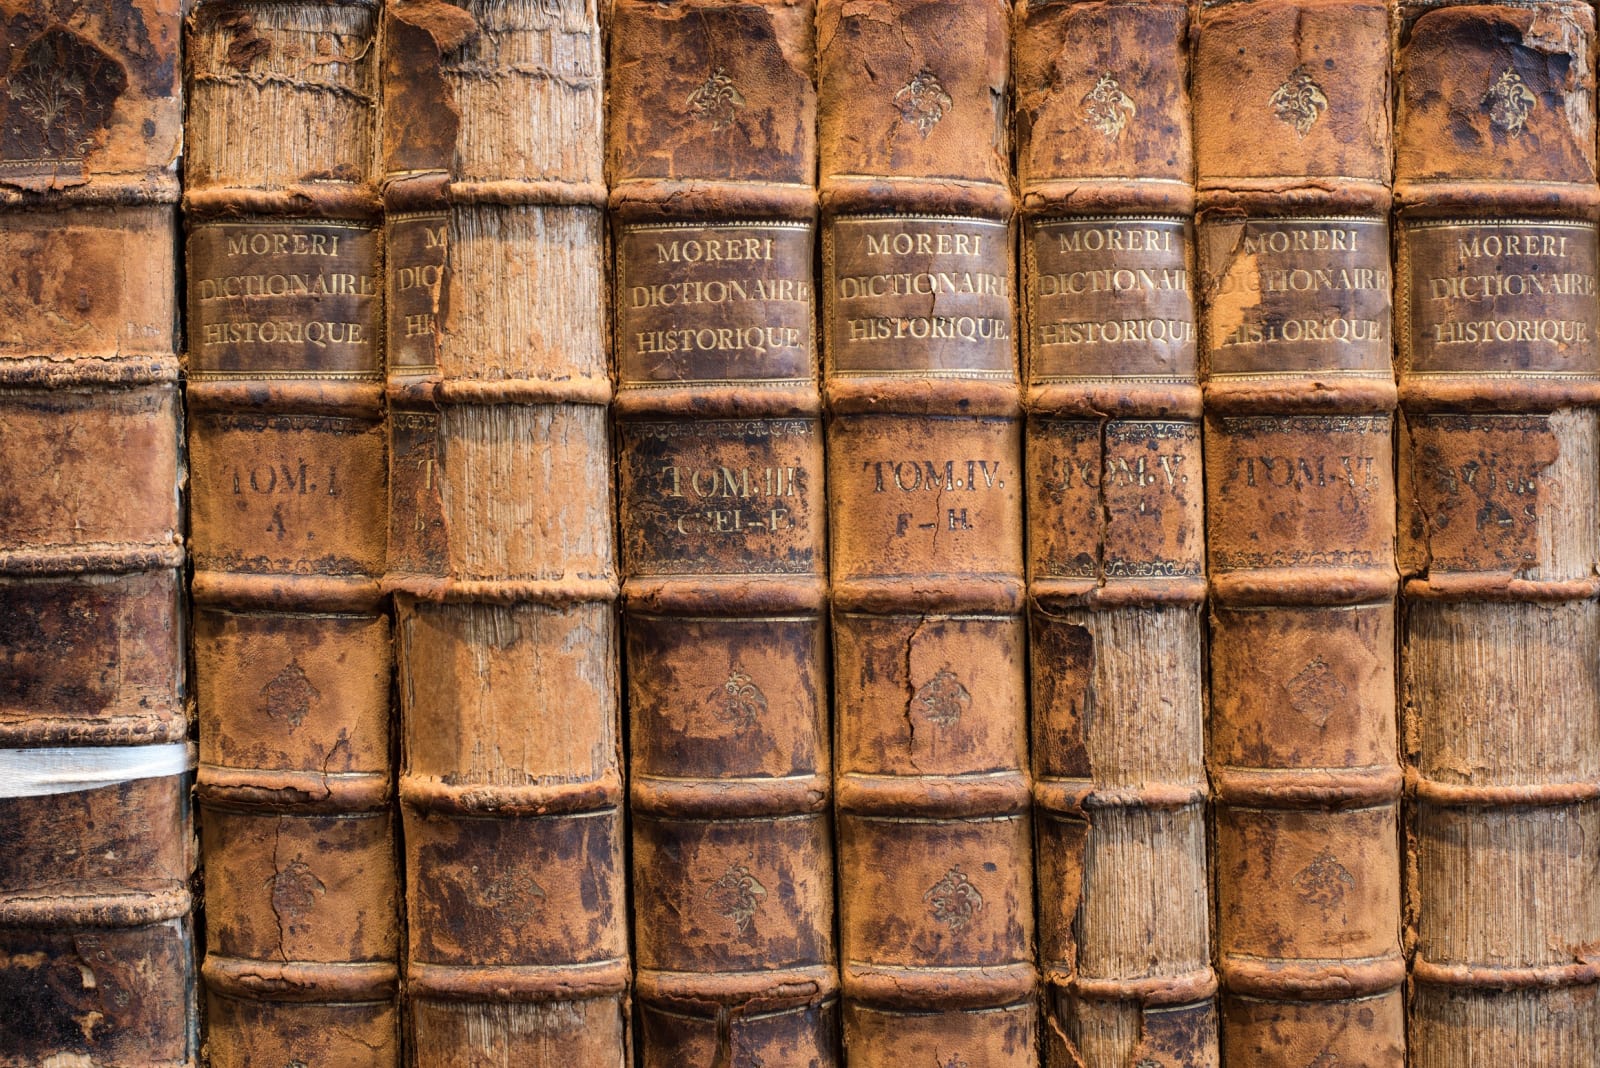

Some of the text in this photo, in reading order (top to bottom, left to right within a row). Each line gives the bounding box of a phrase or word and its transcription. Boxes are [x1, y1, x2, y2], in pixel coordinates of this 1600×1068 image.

[228, 233, 339, 256] MORERI
[657, 239, 773, 263] MORERI
[867, 233, 983, 256] MORERI
[1060, 229, 1171, 254] MORERI
[1246, 229, 1358, 255] MORERI
[1458, 235, 1567, 259] MORERI
[200, 273, 376, 300] DICTIONAIRE
[631, 279, 809, 309] DICTIONAIRE
[1430, 274, 1596, 300] DICTIONAIRE
[204, 321, 368, 347] HISTORIQUE.
[404, 313, 435, 337] HI
[848, 317, 1009, 343] HISTORIQUE.
[1435, 320, 1590, 346] HISTORIQUE.
[636, 326, 803, 354] HISTORIQUE.
